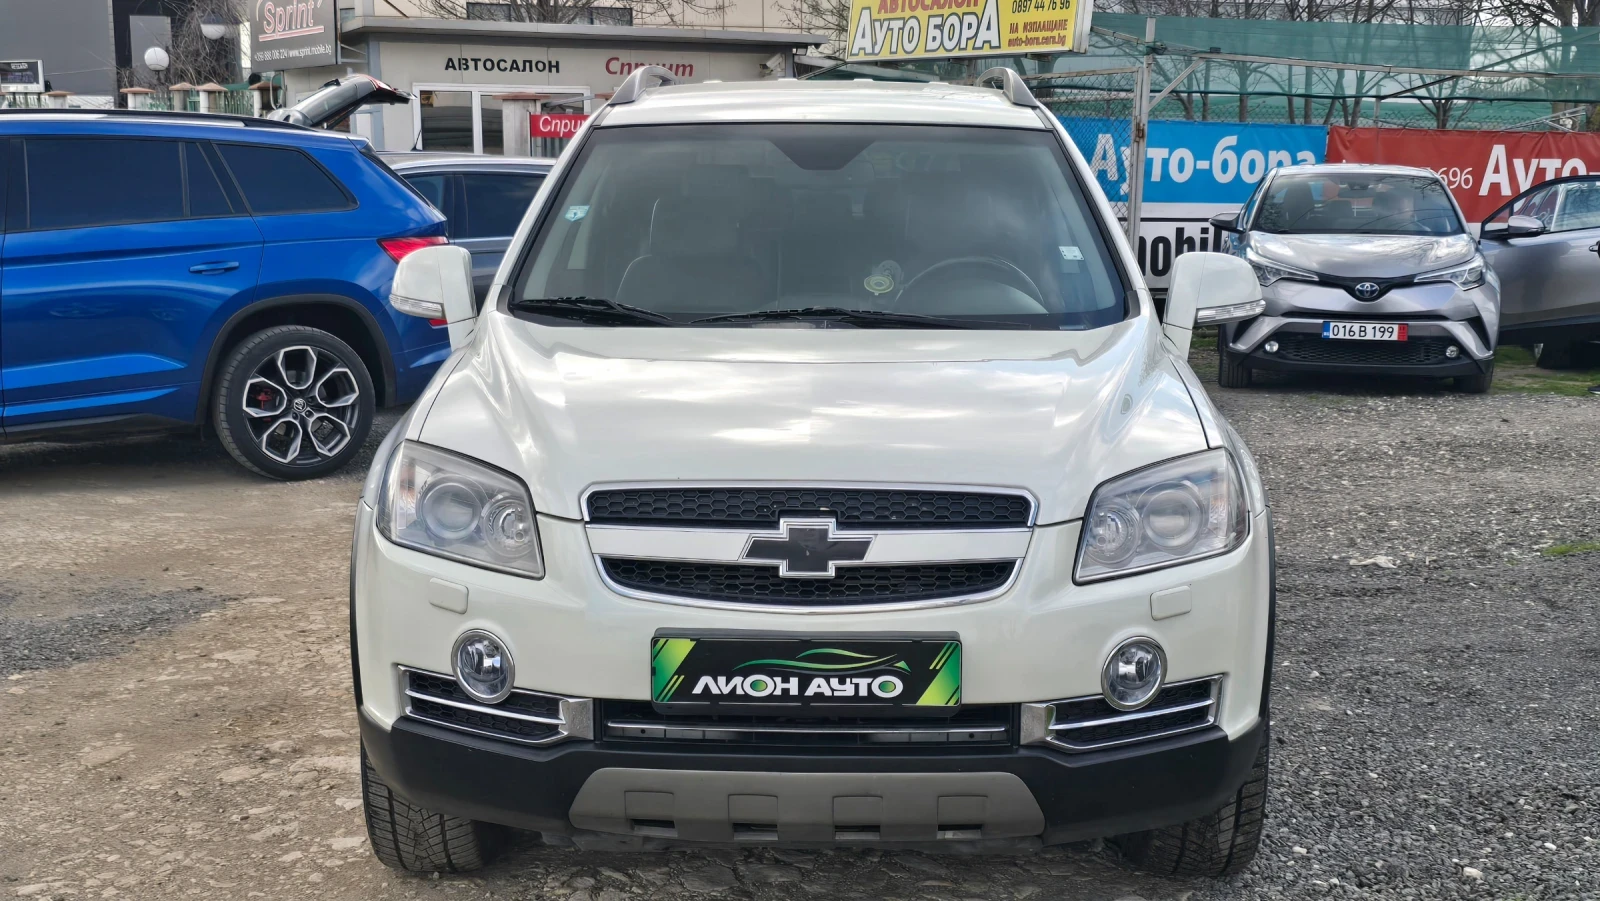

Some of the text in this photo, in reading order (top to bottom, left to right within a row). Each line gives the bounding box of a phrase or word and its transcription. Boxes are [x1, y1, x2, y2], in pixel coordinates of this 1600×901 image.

[1011, 0, 1033, 14] 0897
[1034, 0, 1045, 12] 44
[263, 0, 315, 37] Sprint
[1009, 19, 1068, 34] НА ИЗПЛАЩАНЕ
[445, 57, 560, 73] АВТОСАЛОН
[605, 57, 694, 77] Спт
[1332, 324, 1356, 337] 016
[1358, 325, 1367, 338] B
[1371, 326, 1394, 339] 199
[692, 674, 903, 698] ЛИОН АУТО
